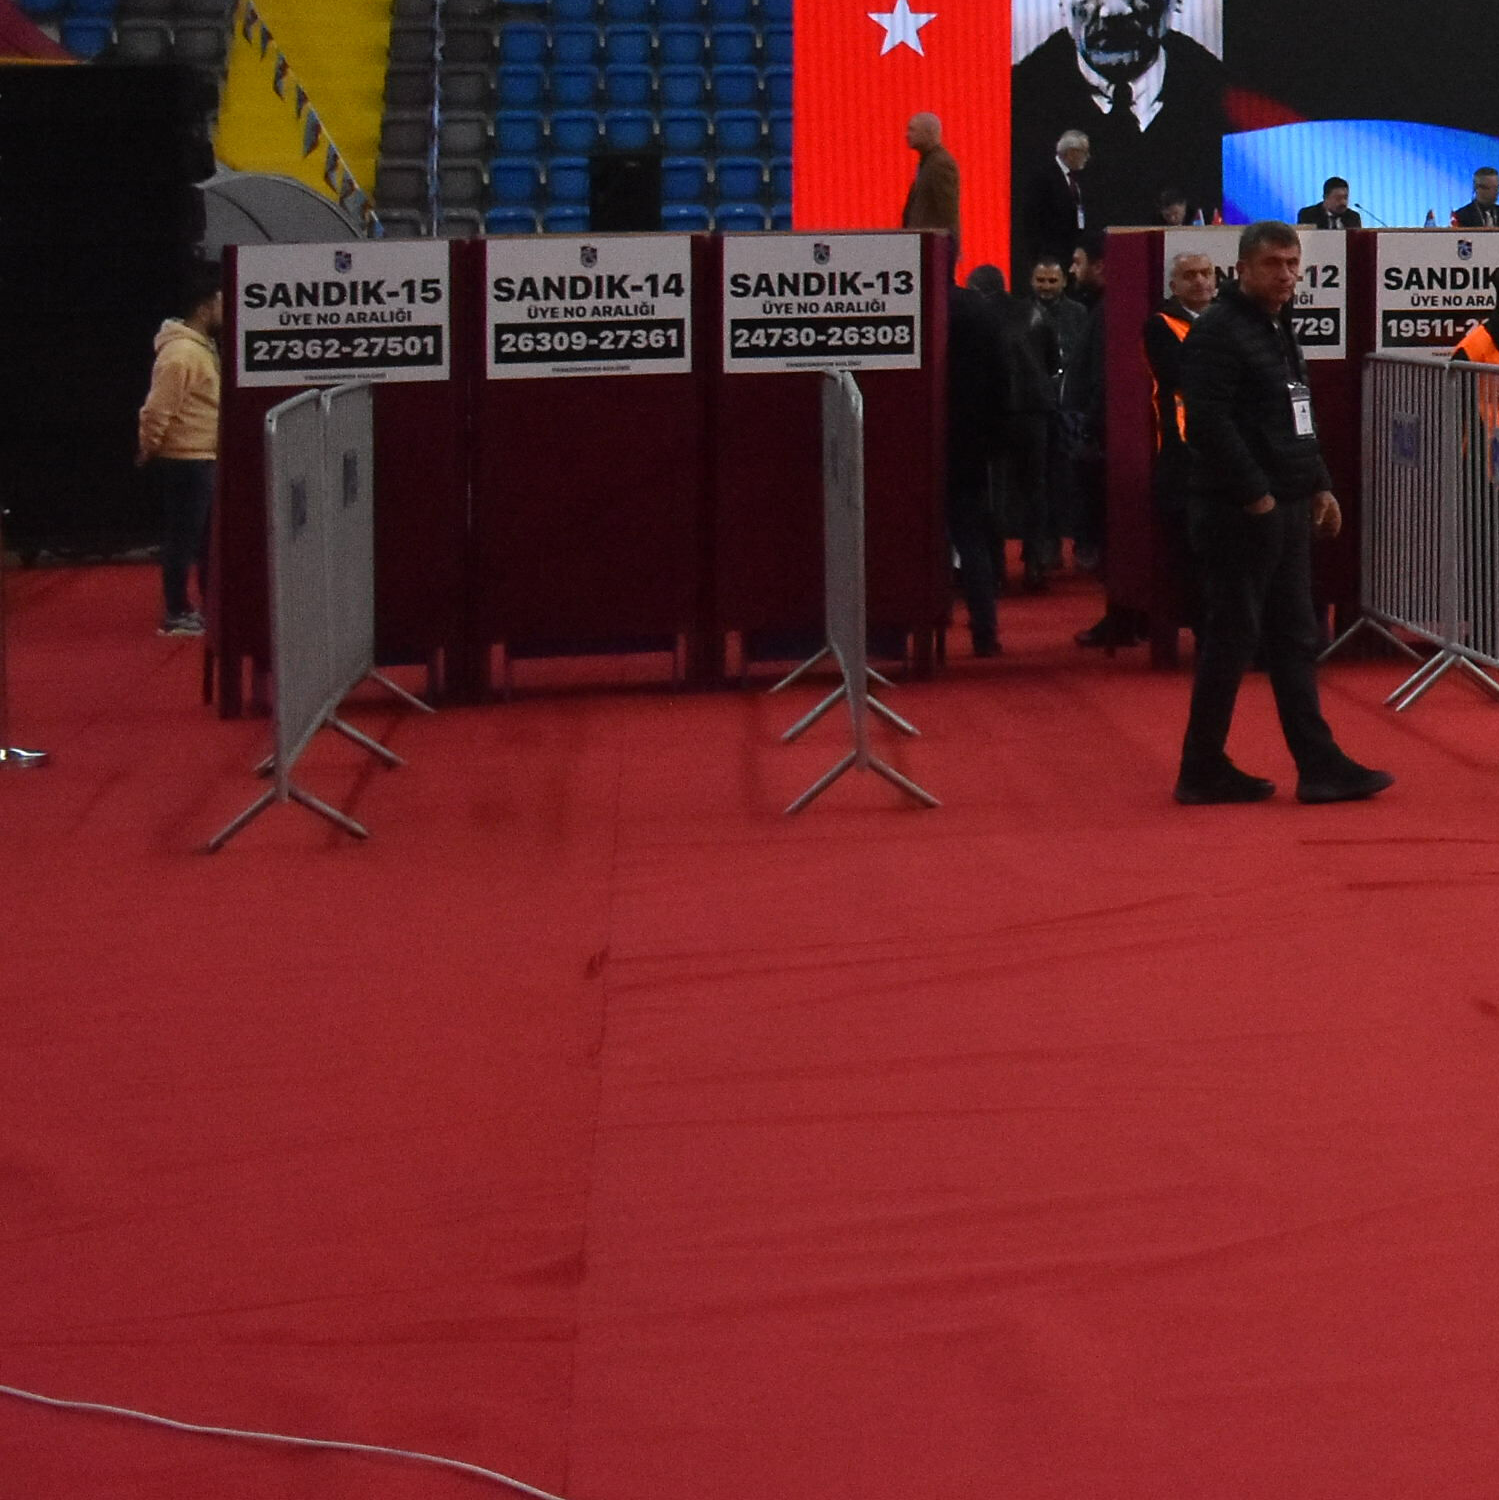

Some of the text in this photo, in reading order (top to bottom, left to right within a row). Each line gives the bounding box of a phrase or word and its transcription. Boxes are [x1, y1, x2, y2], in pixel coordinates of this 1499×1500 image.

[244, 278, 442, 309] SANDIK-15
[493, 273, 685, 302] SANDIK-14
[729, 270, 914, 298] SANDIK-13
[528, 301, 655, 319] ÜYE NO ARALIĞI
[762, 298, 886, 315] ÜYE NO ARALIĞI
[1411, 293, 1438, 307] ÜYE
[1443, 295, 1463, 306] NO
[279, 307, 412, 325] ÜYE NO ARALIĞI
[253, 335, 435, 361] 27362-27501
[500, 328, 679, 353] 26309-27361
[734, 325, 911, 348] 24730-26308
